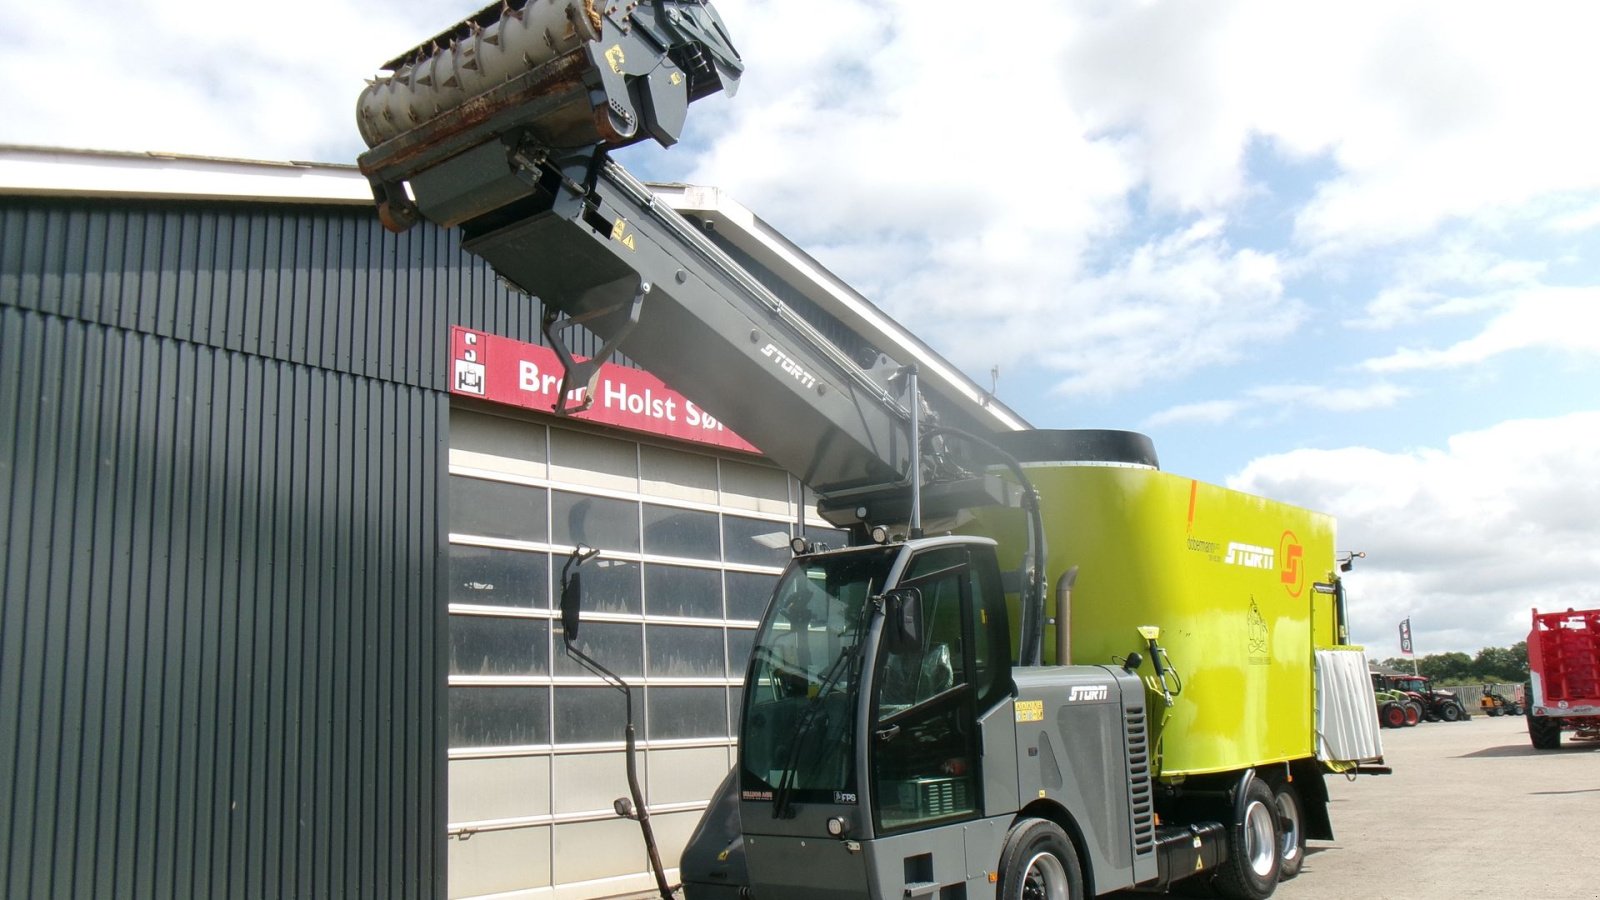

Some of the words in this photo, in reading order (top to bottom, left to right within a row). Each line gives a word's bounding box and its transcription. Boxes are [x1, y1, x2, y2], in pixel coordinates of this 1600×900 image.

[760, 343, 816, 389] STORTI
[604, 379, 677, 421] Holst
[1224, 541, 1275, 570] STORTI
[1068, 685, 1108, 701] STORTI
[841, 794, 856, 802] FPS
